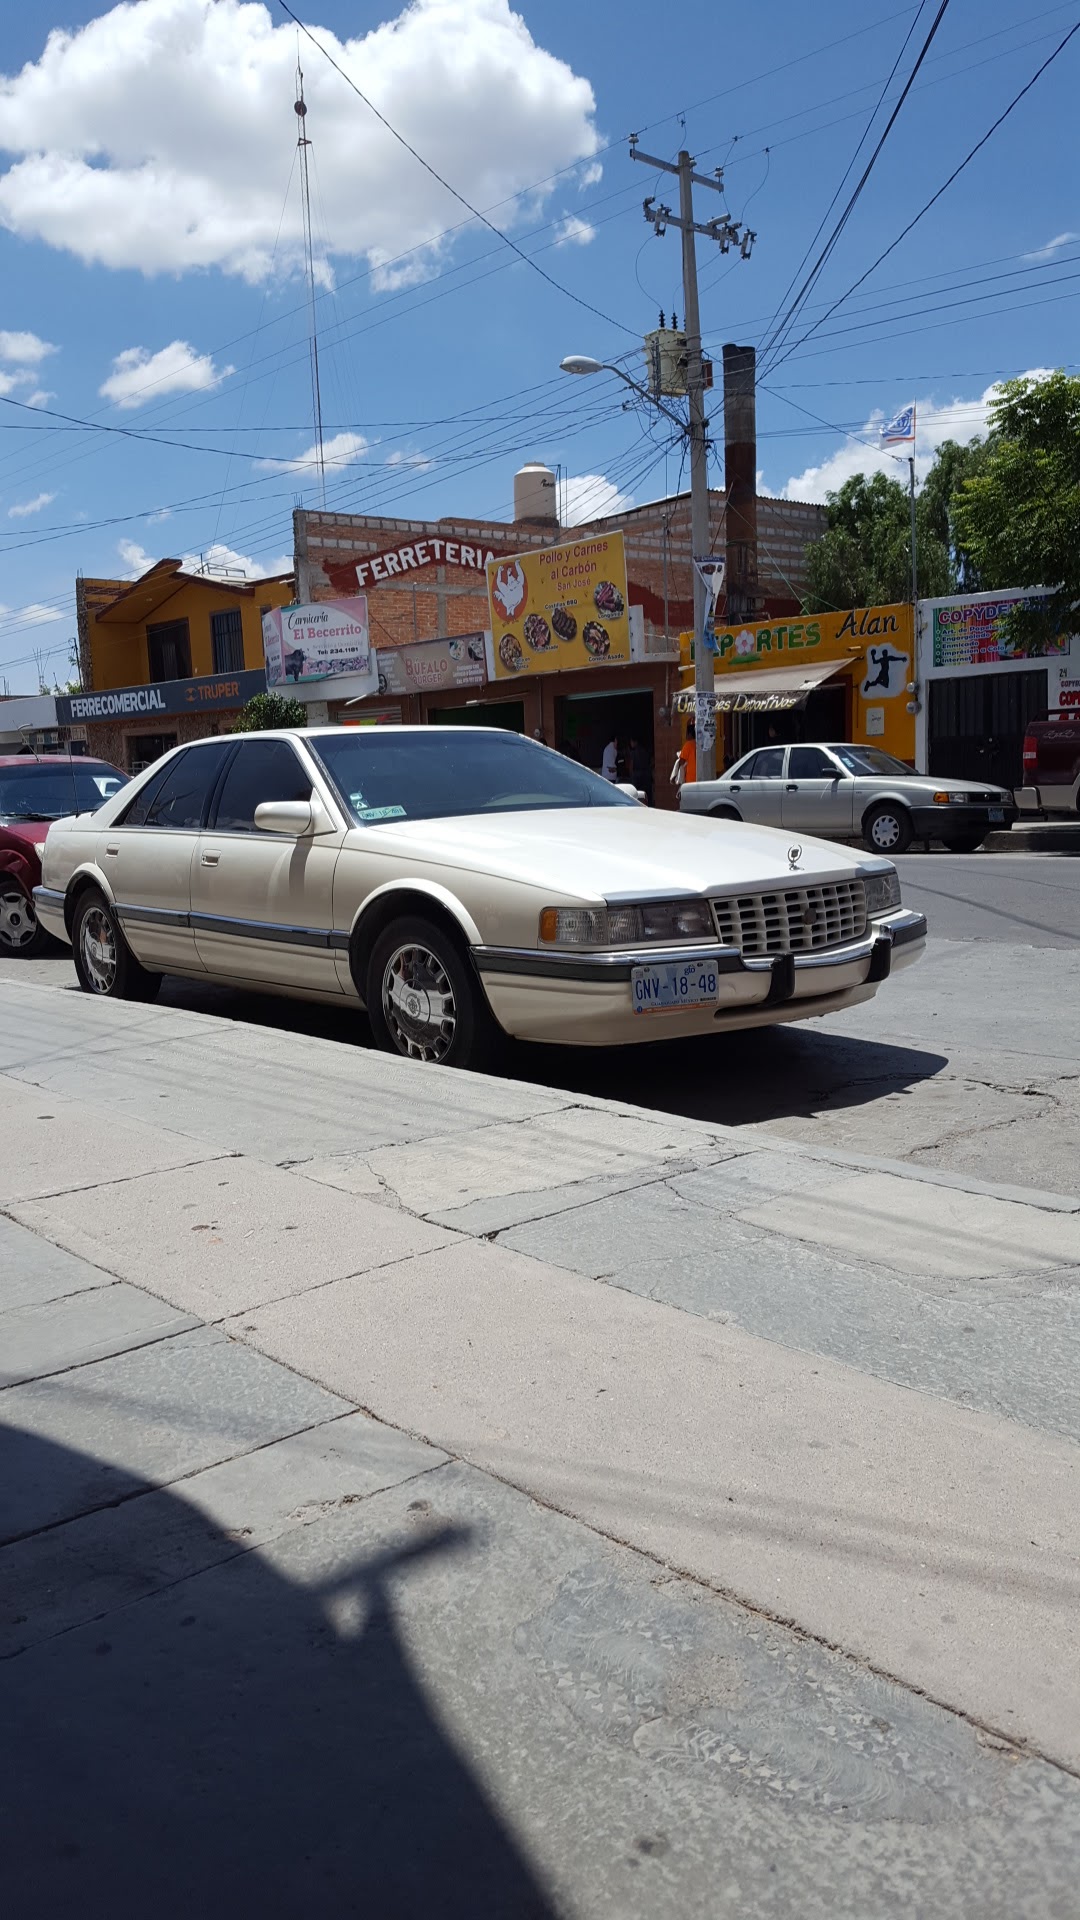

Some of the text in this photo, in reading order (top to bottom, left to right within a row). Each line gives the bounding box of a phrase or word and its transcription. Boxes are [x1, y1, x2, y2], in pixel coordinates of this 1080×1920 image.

[539, 541, 608, 566] Pollo y Carnes
[551, 560, 597, 580] al Carbón
[557, 577, 591, 592] San José
[286, 611, 329, 630] Carnicería
[835, 609, 900, 639] Alan
[293, 628, 304, 641] El
[307, 624, 362, 639] Becerrito
[329, 646, 359, 655] 234.1181
[607, 653, 625, 661] Asado
[942, 655, 972, 664] Internet
[405, 657, 448, 676] BÚFALO
[413, 673, 443, 685] BURGER
[70, 681, 240, 718] FERRECOMERCIAL TRUPER
[732, 694, 797, 713] Deportivos
[635, 973, 717, 1001] GNV-18-48
